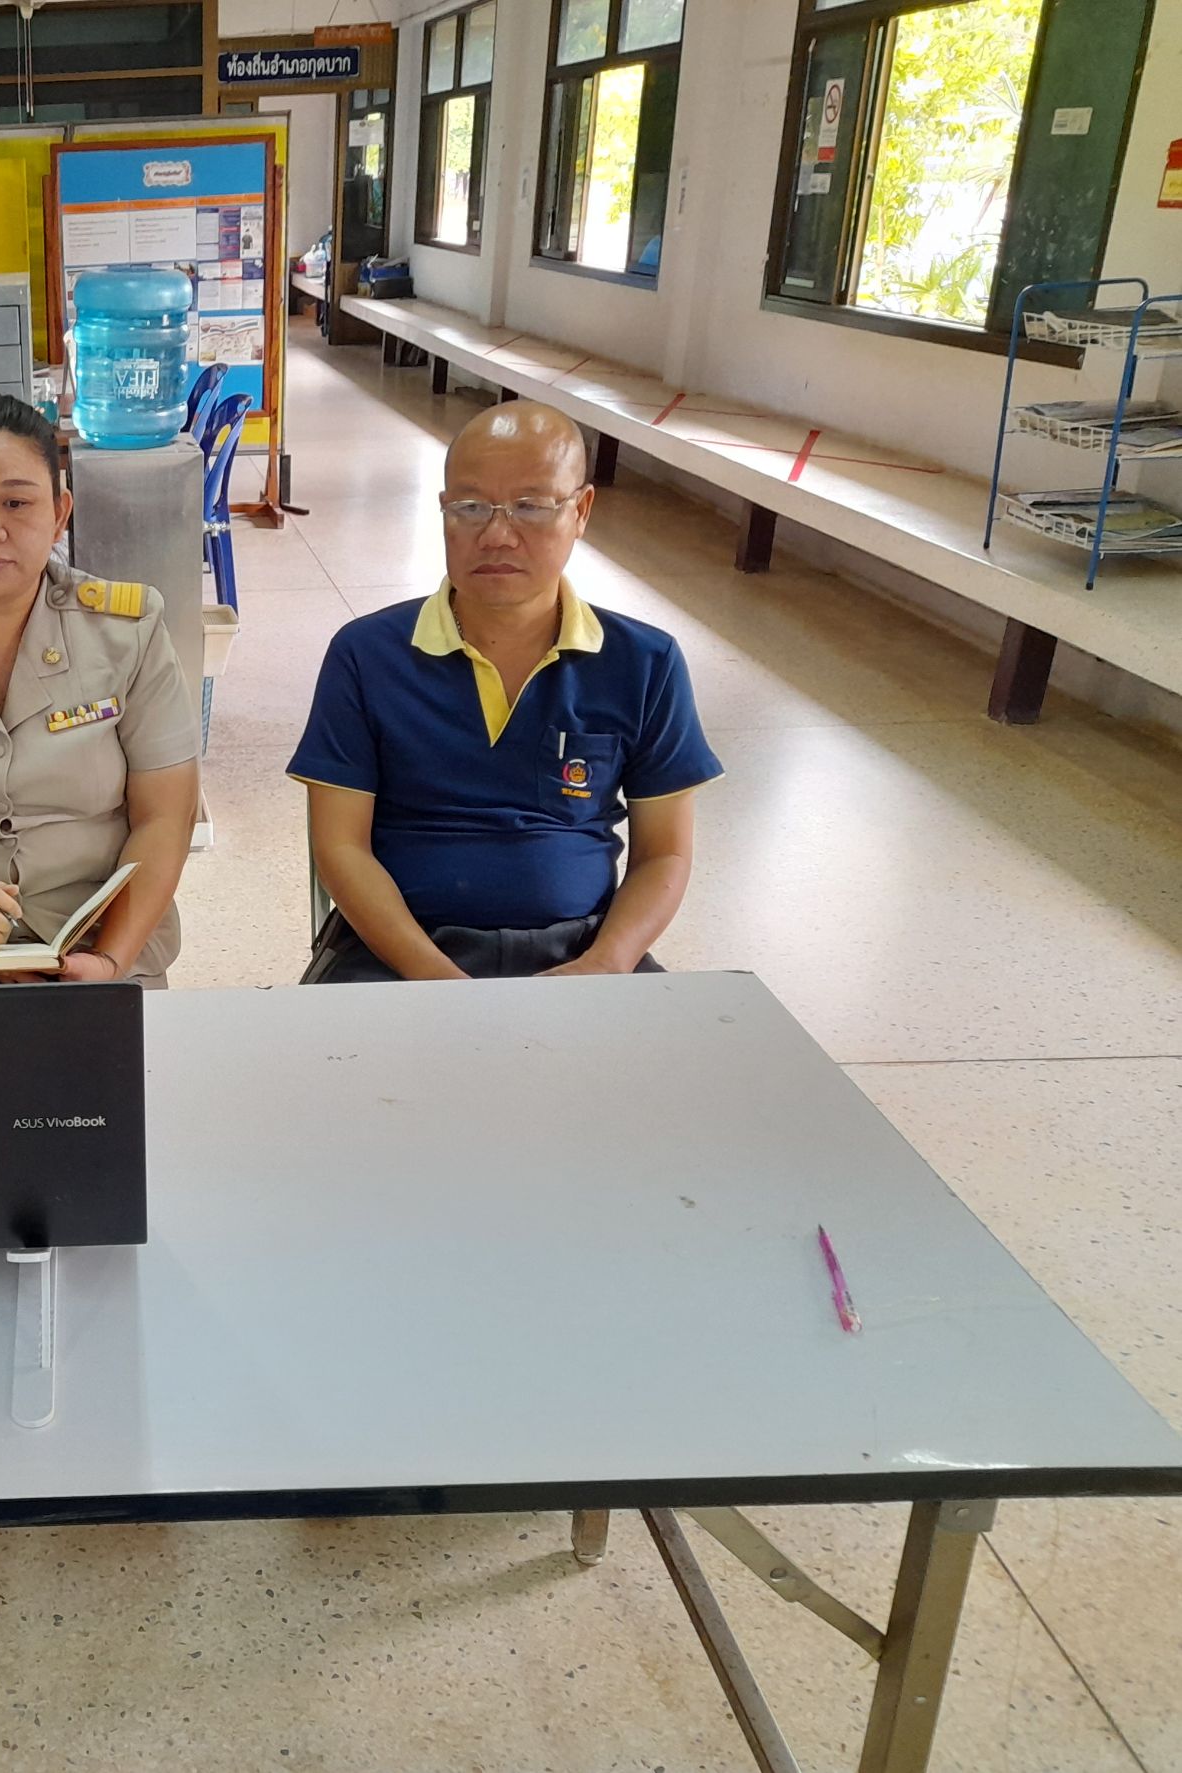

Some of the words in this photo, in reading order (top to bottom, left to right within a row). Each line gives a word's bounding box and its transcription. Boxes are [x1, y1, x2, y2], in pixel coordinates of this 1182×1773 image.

[226, 52, 351, 79] ท้องถิ่นอำเภอกุดบาก
[116, 370, 157, 387] FIFA
[13, 1118, 44, 1129] ASUS
[47, 1116, 106, 1128] VivoBook
